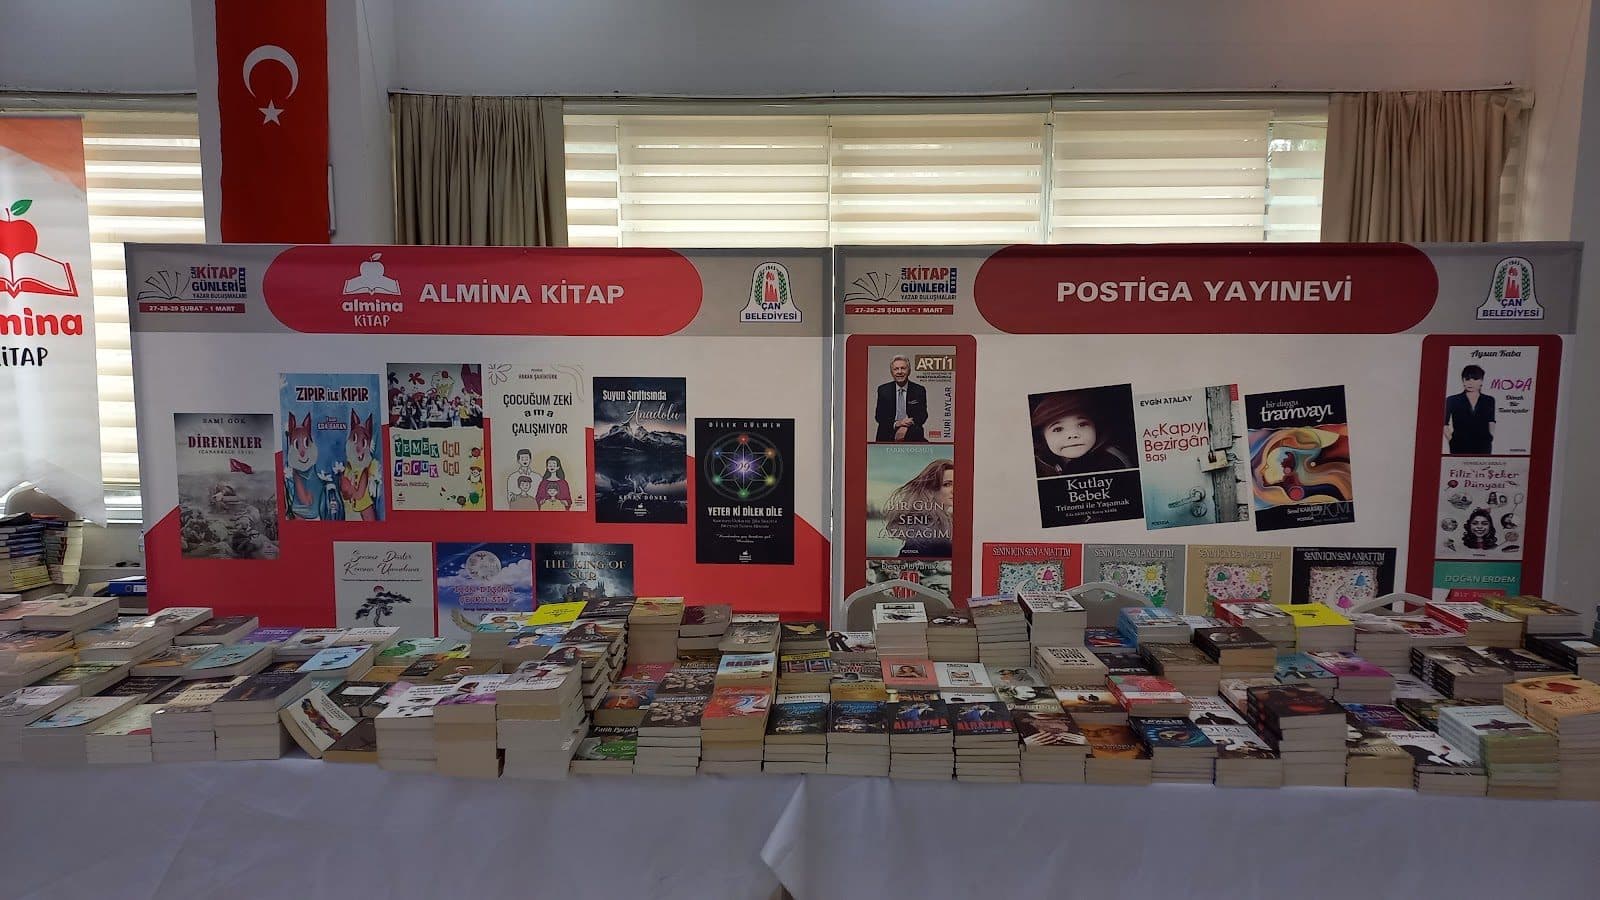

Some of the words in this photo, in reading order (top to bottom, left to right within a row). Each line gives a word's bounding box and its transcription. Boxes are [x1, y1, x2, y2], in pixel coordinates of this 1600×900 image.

[196, 264, 238, 279] KİTAP
[907, 264, 949, 280] KİTAP
[191, 280, 239, 292] GÜNLERİ
[419, 278, 532, 304] ALMİNA
[541, 279, 625, 304] KİTAP
[900, 280, 949, 293] GÜNLERİ
[1057, 276, 1193, 302] POSTİGA
[1203, 275, 1353, 302] YAYINEVİ
[180, 304, 203, 314] ŞUBAT
[342, 299, 403, 313] almina
[761, 302, 781, 312] ÇAN
[1501, 298, 1522, 309] ÇAN
[745, 311, 797, 320] BELEDİYESİ
[887, 306, 911, 315] ŞUBAT
[1482, 307, 1540, 318] BELEDİYESİ
[1490, 377, 1533, 392] MODA
[295, 386, 326, 402] ZIPIR
[340, 386, 369, 402] KIPIR
[503, 391, 550, 408] ÇOCUĞUM
[552, 391, 573, 406] ZEKİ
[602, 389, 626, 401] Suyun
[1163, 395, 1193, 405] ATALAY
[523, 408, 554, 418] ama
[1260, 403, 1334, 424] tramvayı
[511, 422, 568, 437] ÇALIŞMIYOR
[188, 433, 262, 449] DİRENENLER
[394, 437, 440, 458] YEMEK
[1143, 433, 1210, 454] Bezirgân
[1145, 451, 1168, 463] Başı
[393, 459, 440, 478] ÇOCUK
[1487, 469, 1520, 480] Şeker
[1066, 476, 1114, 491] Kutlay
[1068, 488, 1112, 503] Bebek
[707, 506, 731, 517] YETER
[732, 505, 741, 517] Kİ
[742, 505, 765, 517] DİLEK
[766, 505, 783, 517] DİLE
[544, 559, 568, 569] THE
[574, 559, 605, 570] KING
[608, 560, 626, 569] OF
[568, 569, 597, 581] SUR
[1482, 575, 1516, 583] ERDEM
